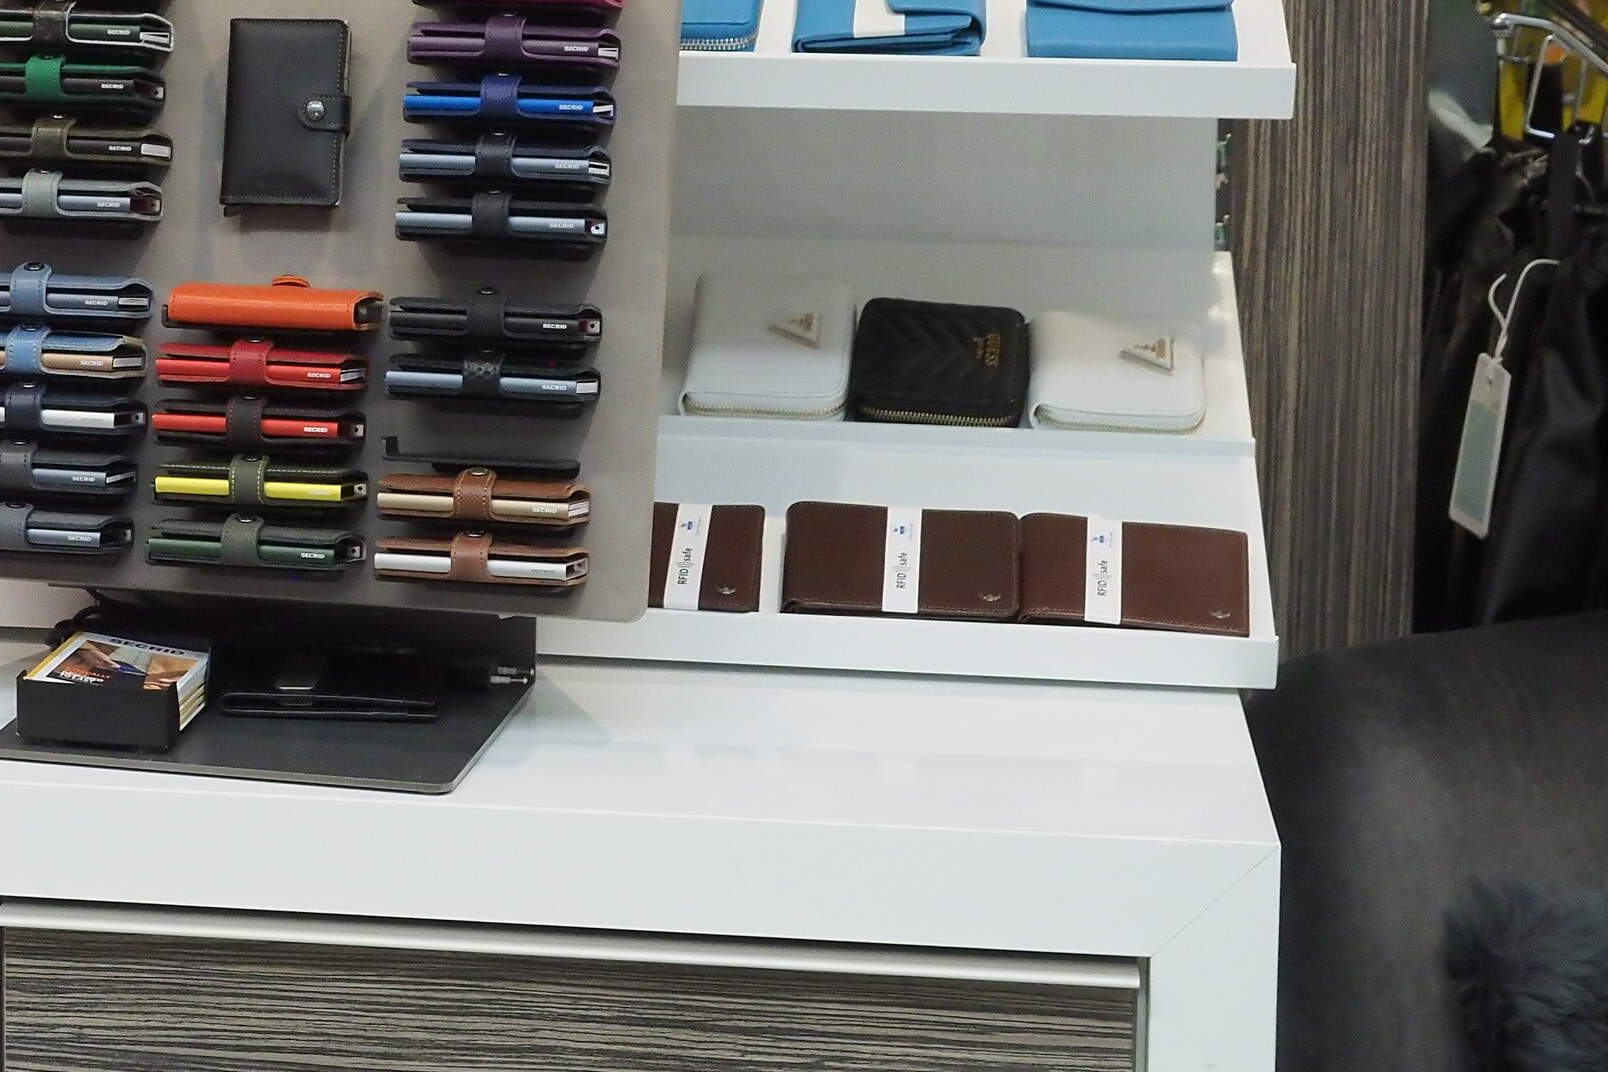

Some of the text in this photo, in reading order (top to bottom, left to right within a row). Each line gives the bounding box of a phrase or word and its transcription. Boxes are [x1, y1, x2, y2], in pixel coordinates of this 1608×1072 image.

[683, 547, 694, 563] safe
[896, 552, 908, 589] RFID safe
[1099, 560, 1109, 574] safe
[677, 568, 690, 585] RFID
[1097, 580, 1108, 597] RFID
[109, 638, 185, 655] SECRID
